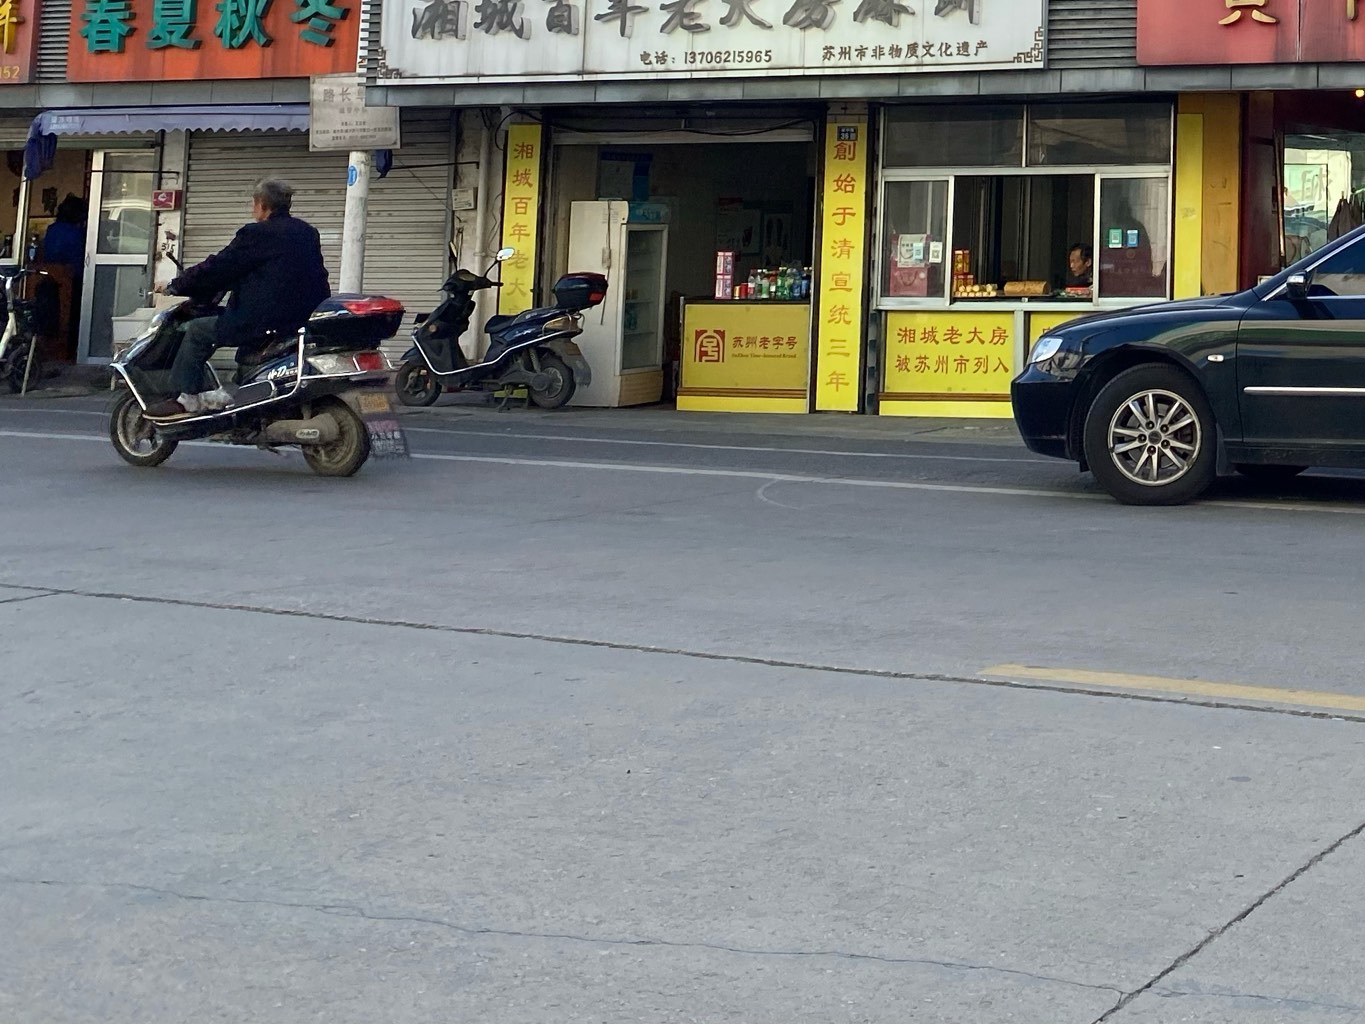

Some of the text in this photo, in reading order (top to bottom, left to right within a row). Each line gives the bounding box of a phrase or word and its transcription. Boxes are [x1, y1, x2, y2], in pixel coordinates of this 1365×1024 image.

[684, 49, 772, 64] 13706215965
[0, 66, 20, 79] 52
[897, 326, 1010, 346] 湘城老大房
[895, 354, 1010, 375] 被苏州市列入
